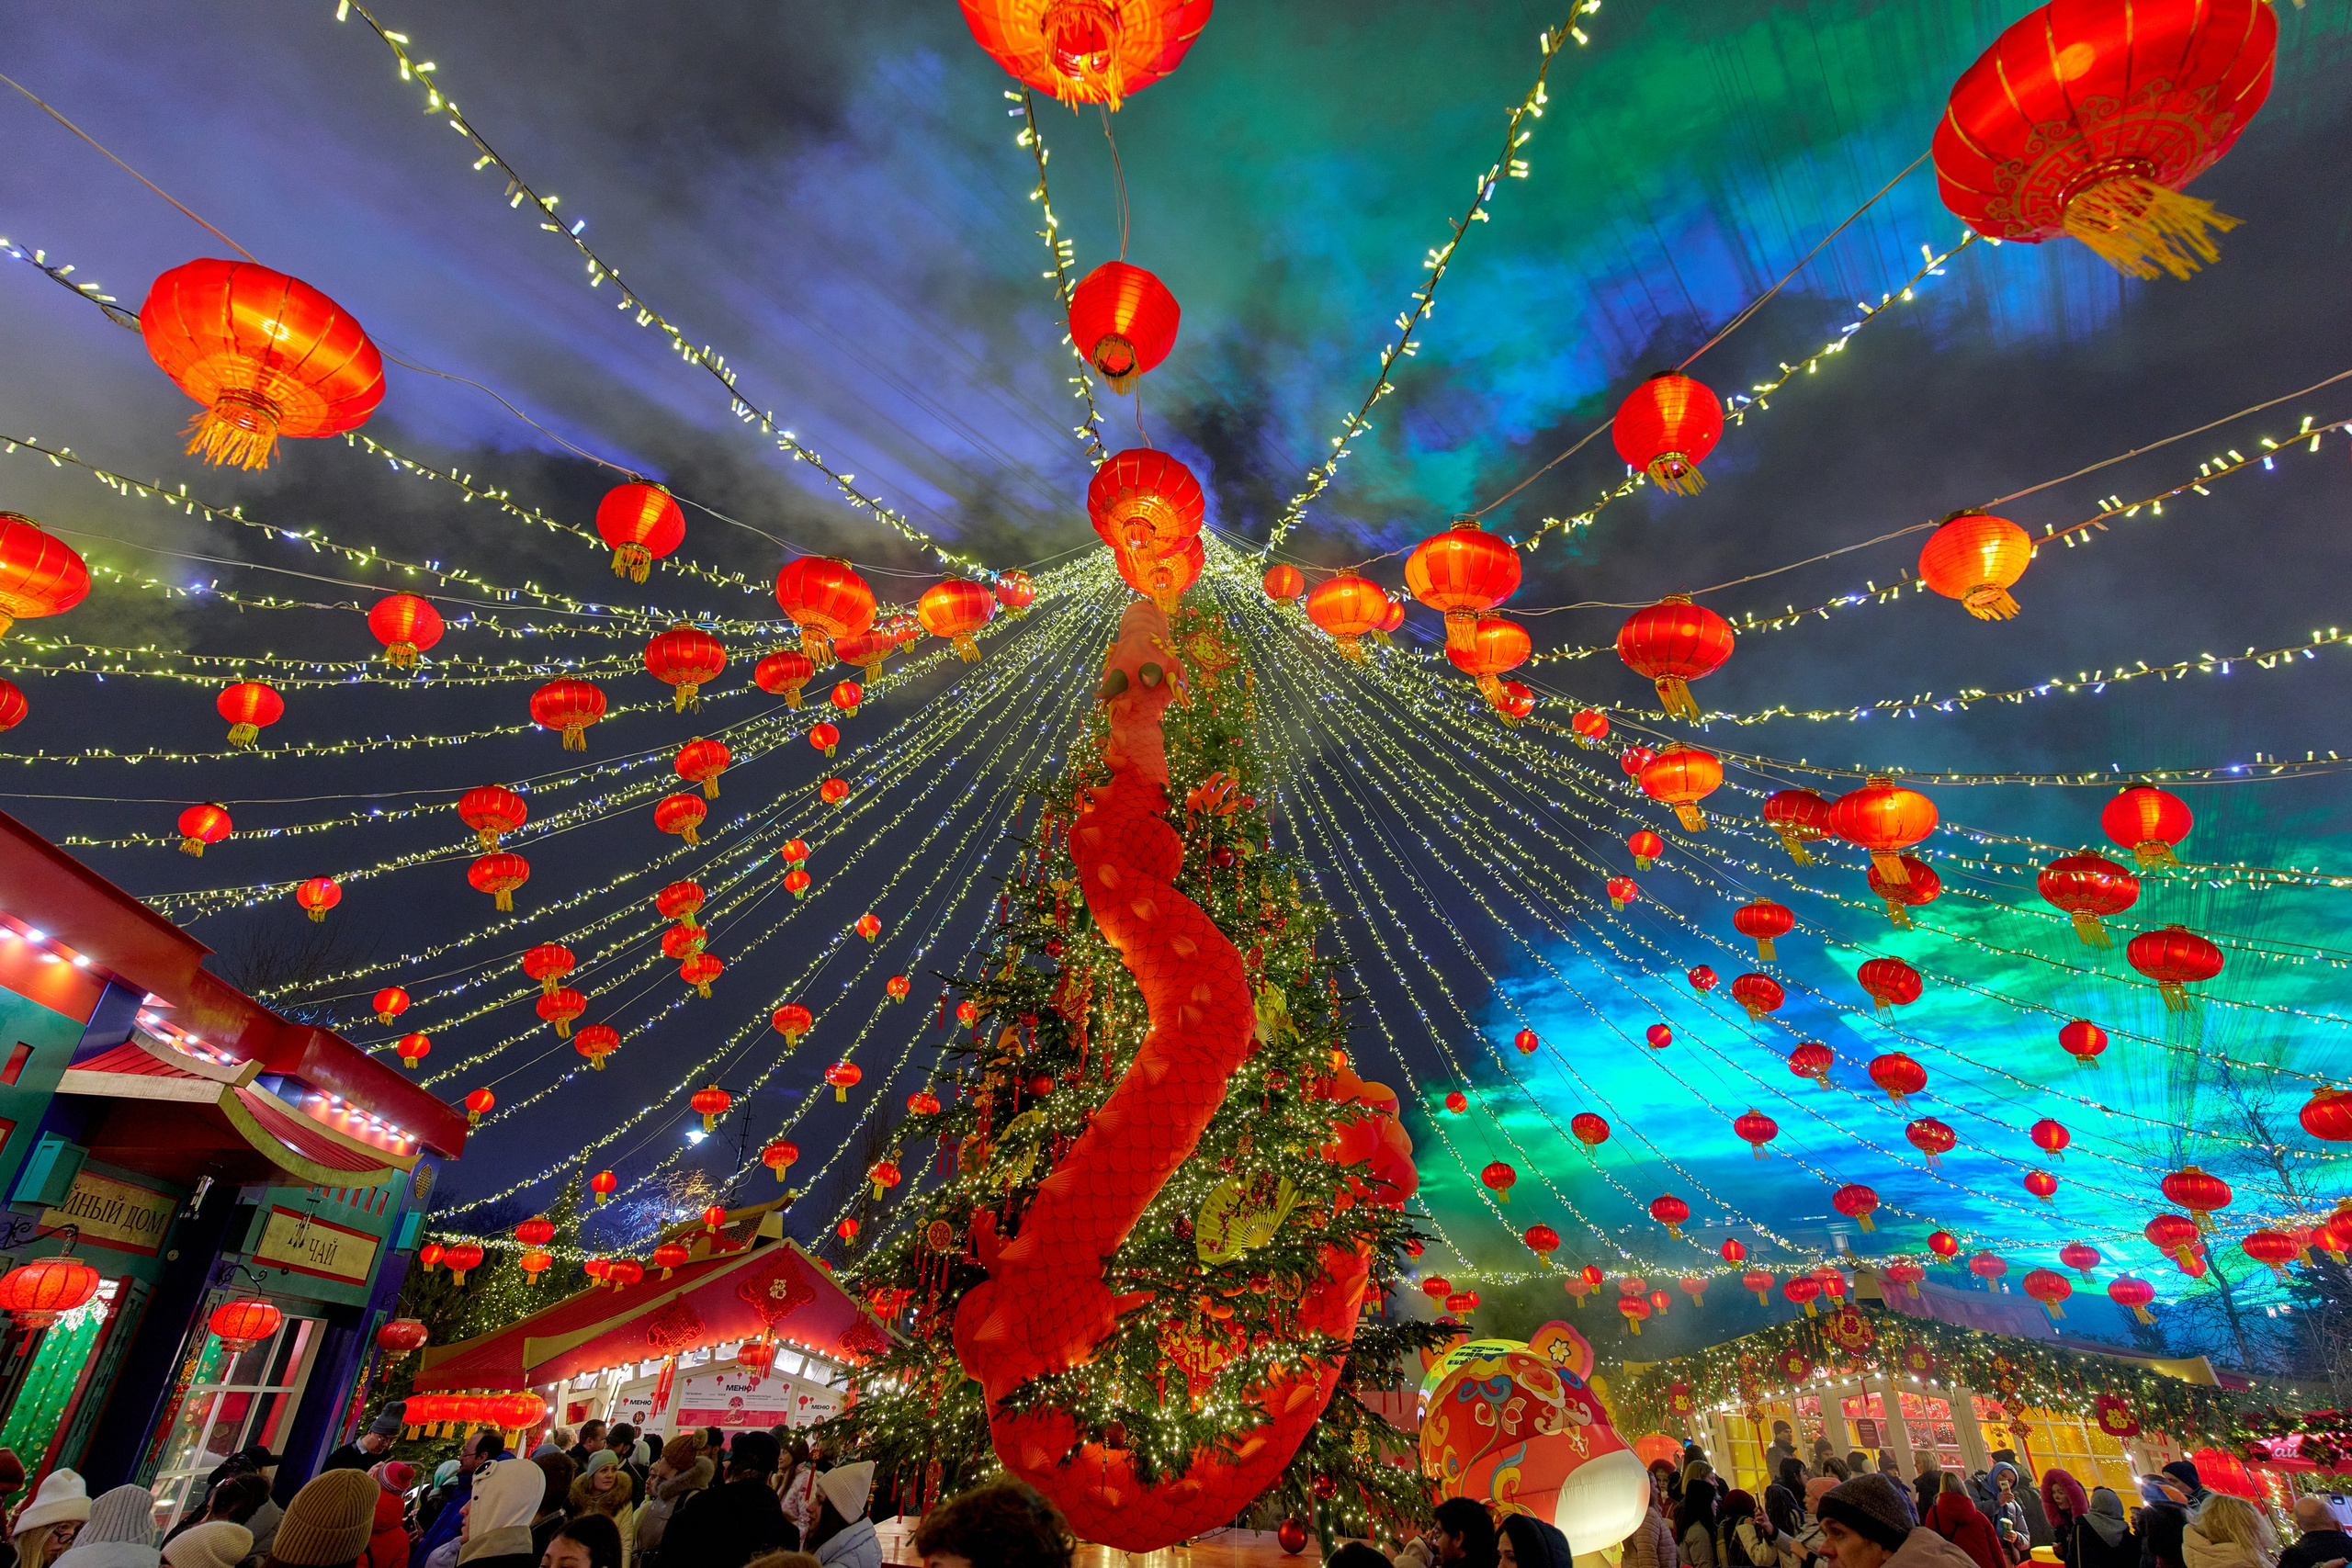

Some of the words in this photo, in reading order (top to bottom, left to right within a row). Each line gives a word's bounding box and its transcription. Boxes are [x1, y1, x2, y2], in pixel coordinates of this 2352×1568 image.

[52, 1182, 125, 1224] ЙНЫЙ
[119, 1205, 165, 1234] ДОМ
[309, 1237, 338, 1266] ЧАЙ
[2262, 1440, 2300, 1459] ай
